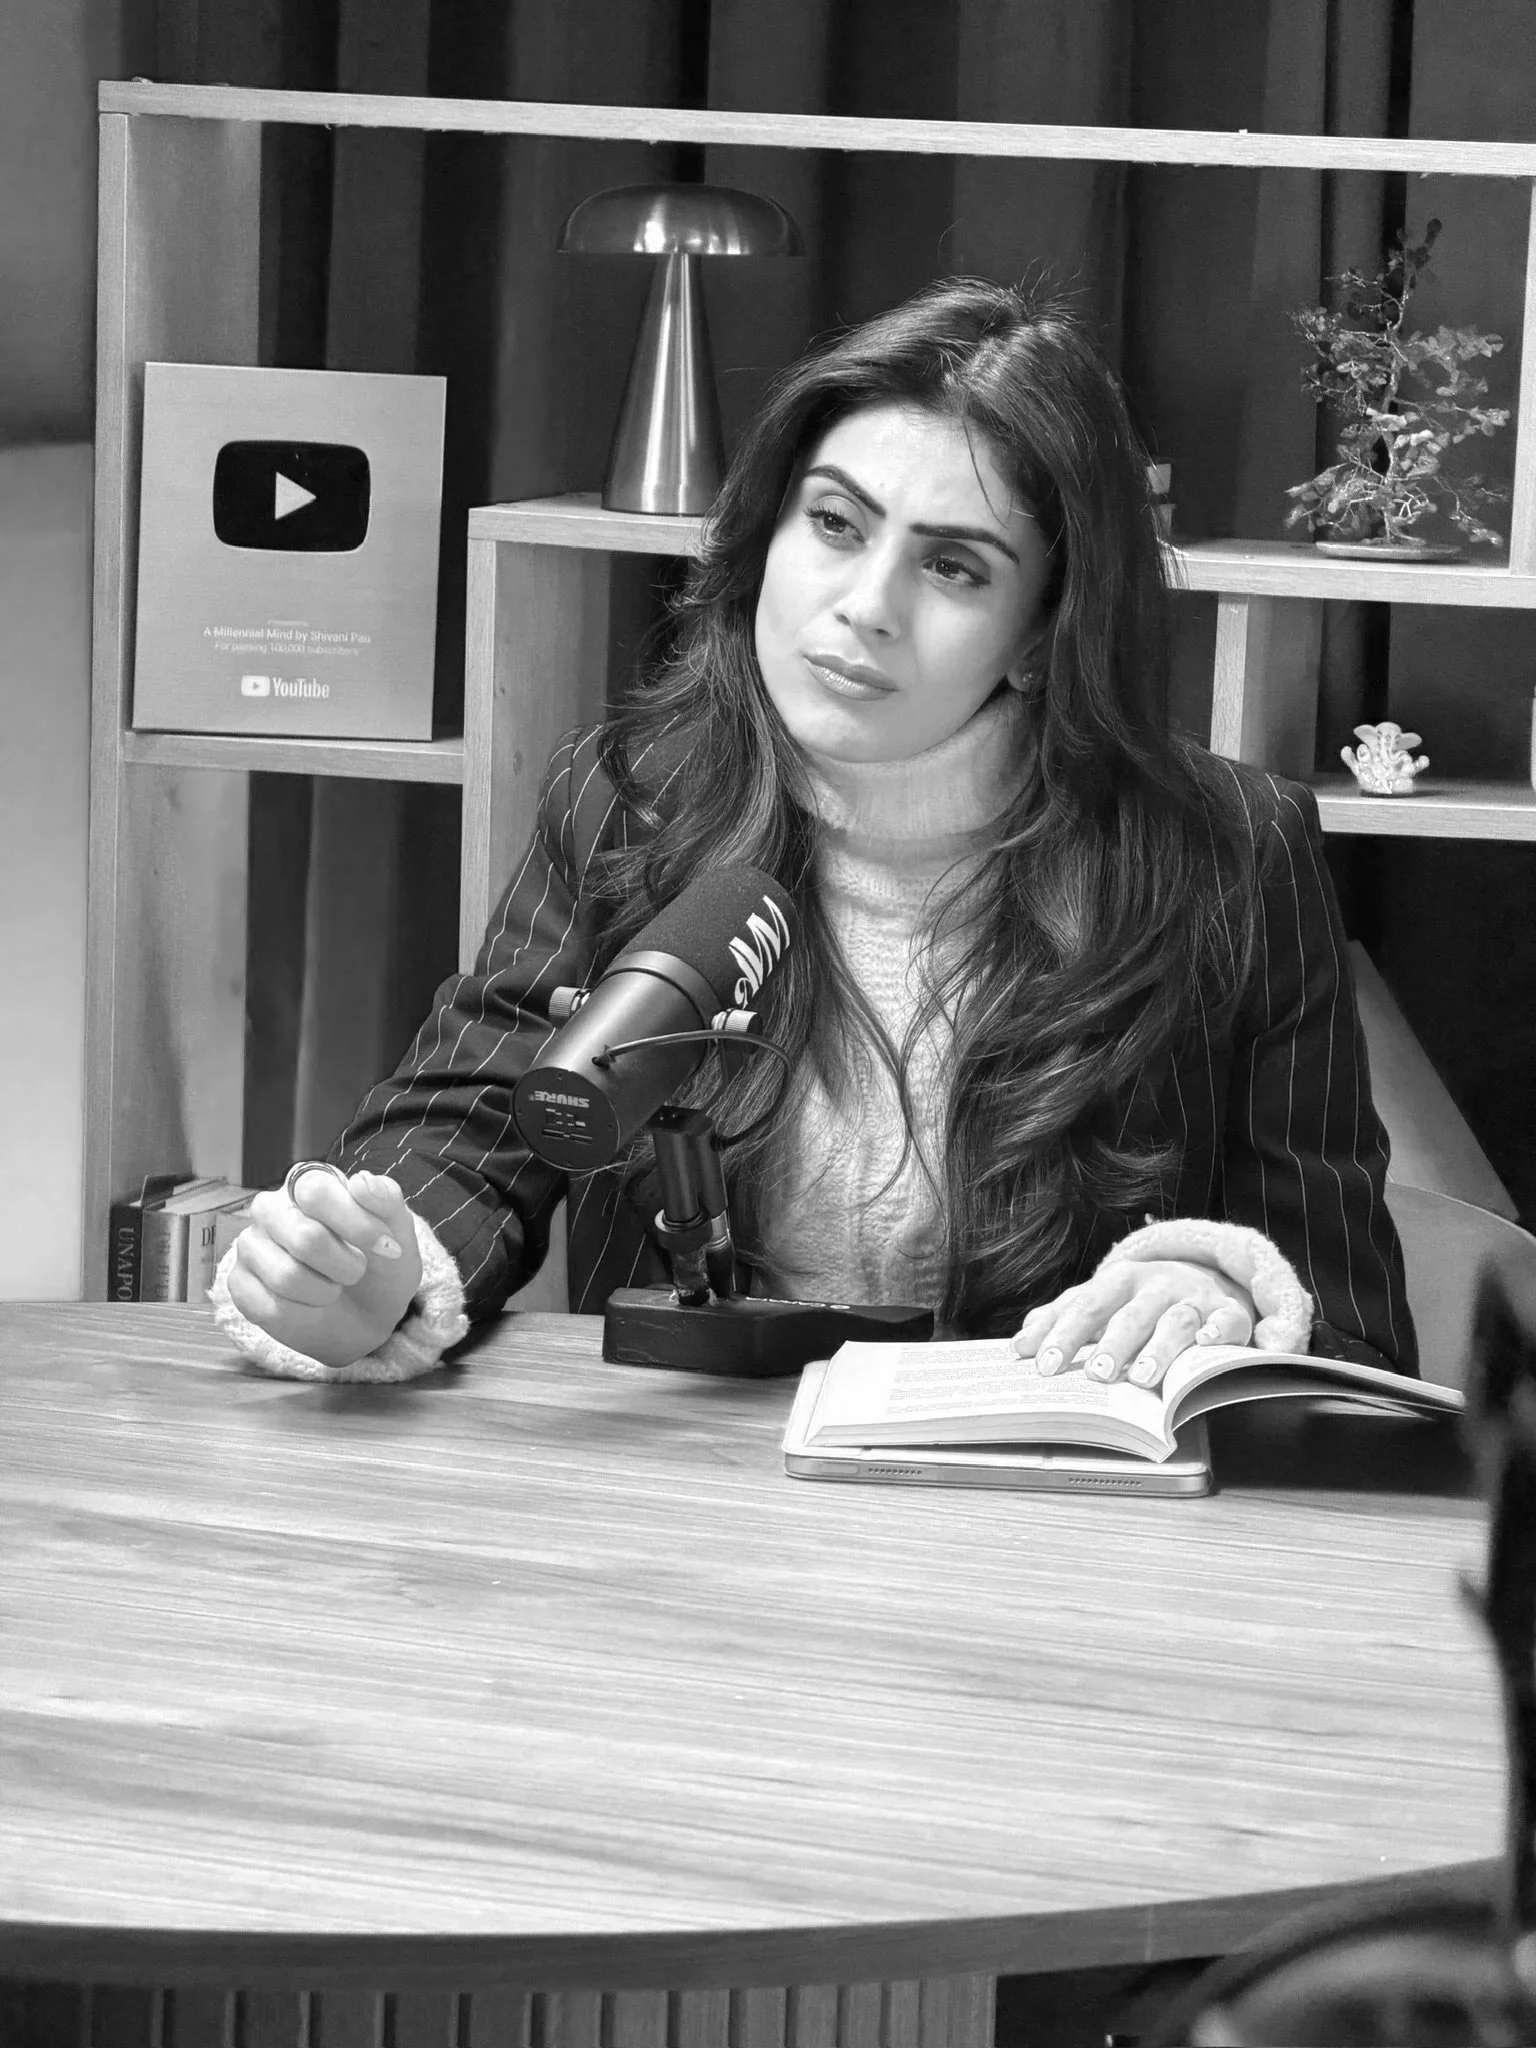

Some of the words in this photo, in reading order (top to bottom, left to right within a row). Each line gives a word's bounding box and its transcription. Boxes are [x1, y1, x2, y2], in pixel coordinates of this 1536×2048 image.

[203, 626, 212, 637] A
[213, 626, 264, 639] Millennial
[266, 628, 293, 641] Mind
[295, 629, 308, 643] by
[310, 630, 349, 643] Shivani
[214, 640, 231, 650] For
[272, 677, 331, 698] YouTube
[534, 1090, 590, 1108] SHURE
[116, 1227, 135, 1301] UNAPO
